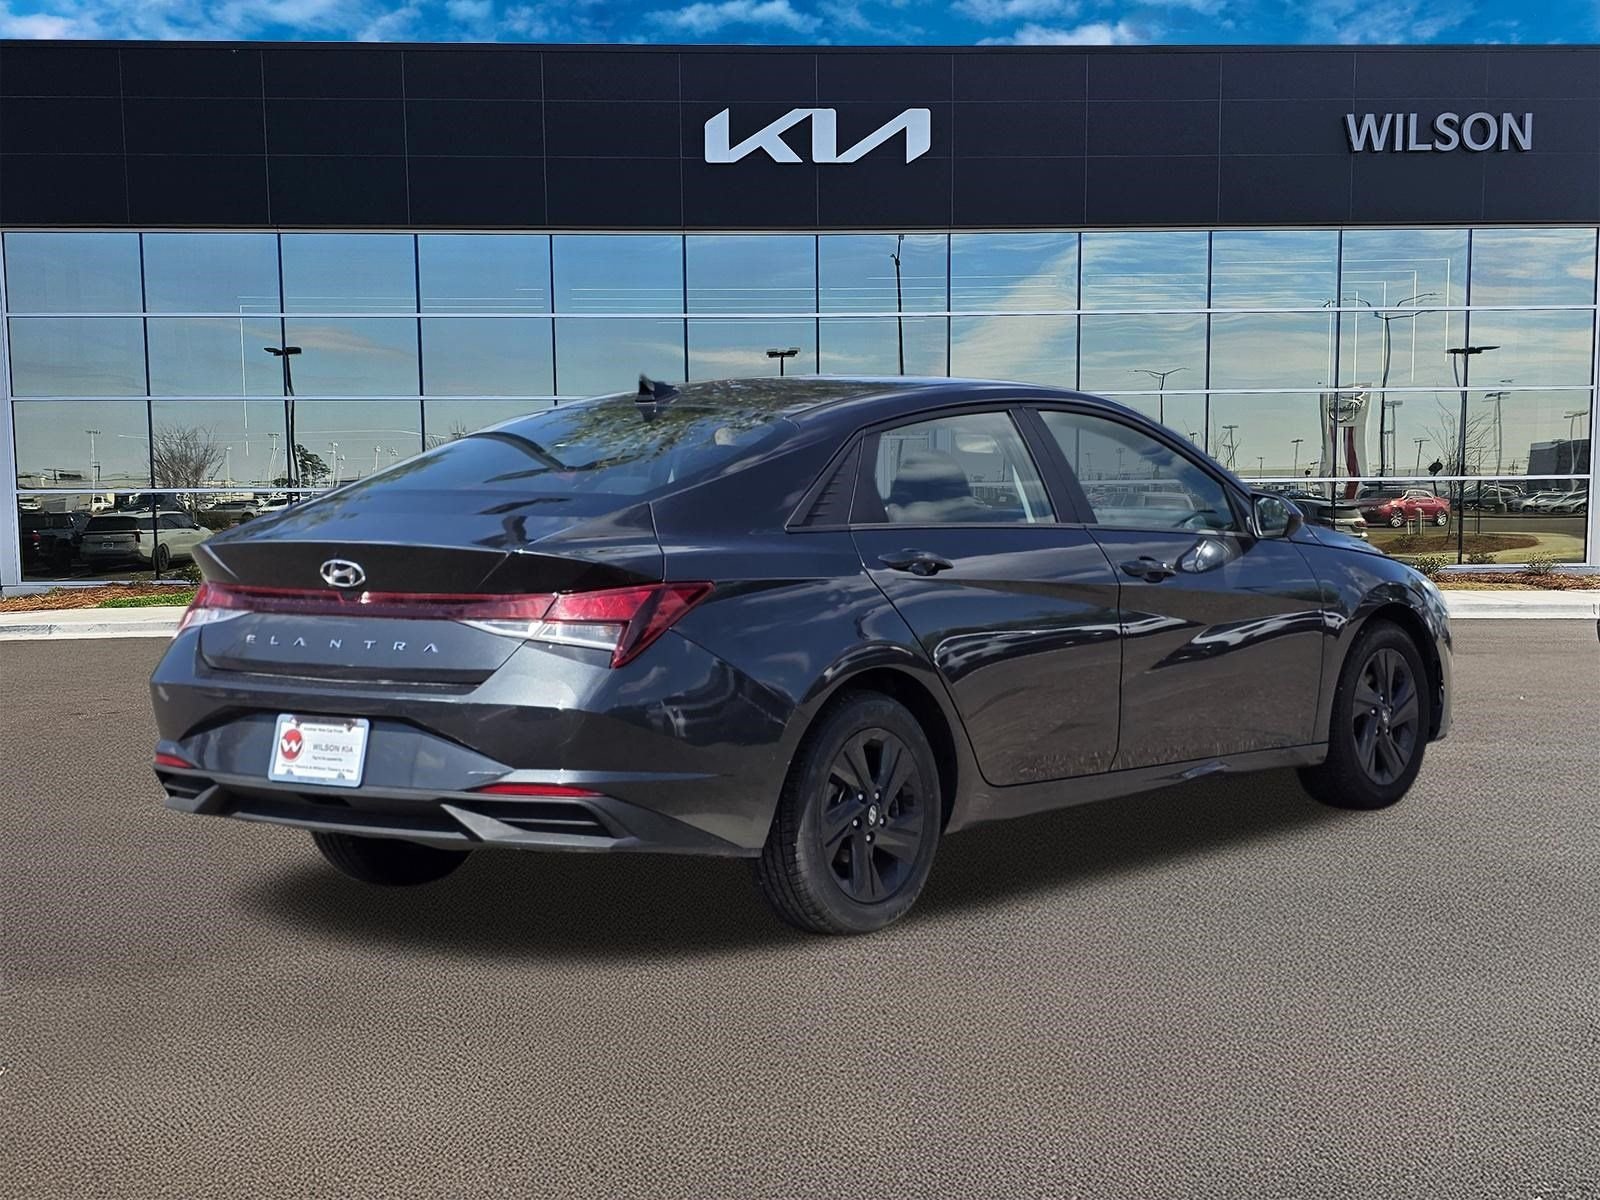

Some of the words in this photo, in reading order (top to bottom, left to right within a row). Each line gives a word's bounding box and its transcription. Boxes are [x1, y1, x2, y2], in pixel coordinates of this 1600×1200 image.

[704, 107, 932, 164] KIA
[1345, 112, 1534, 152] WILSON
[245, 634, 439, 654] ELANTRA
[312, 743, 340, 752] WILSON
[341, 744, 353, 753] KIA
